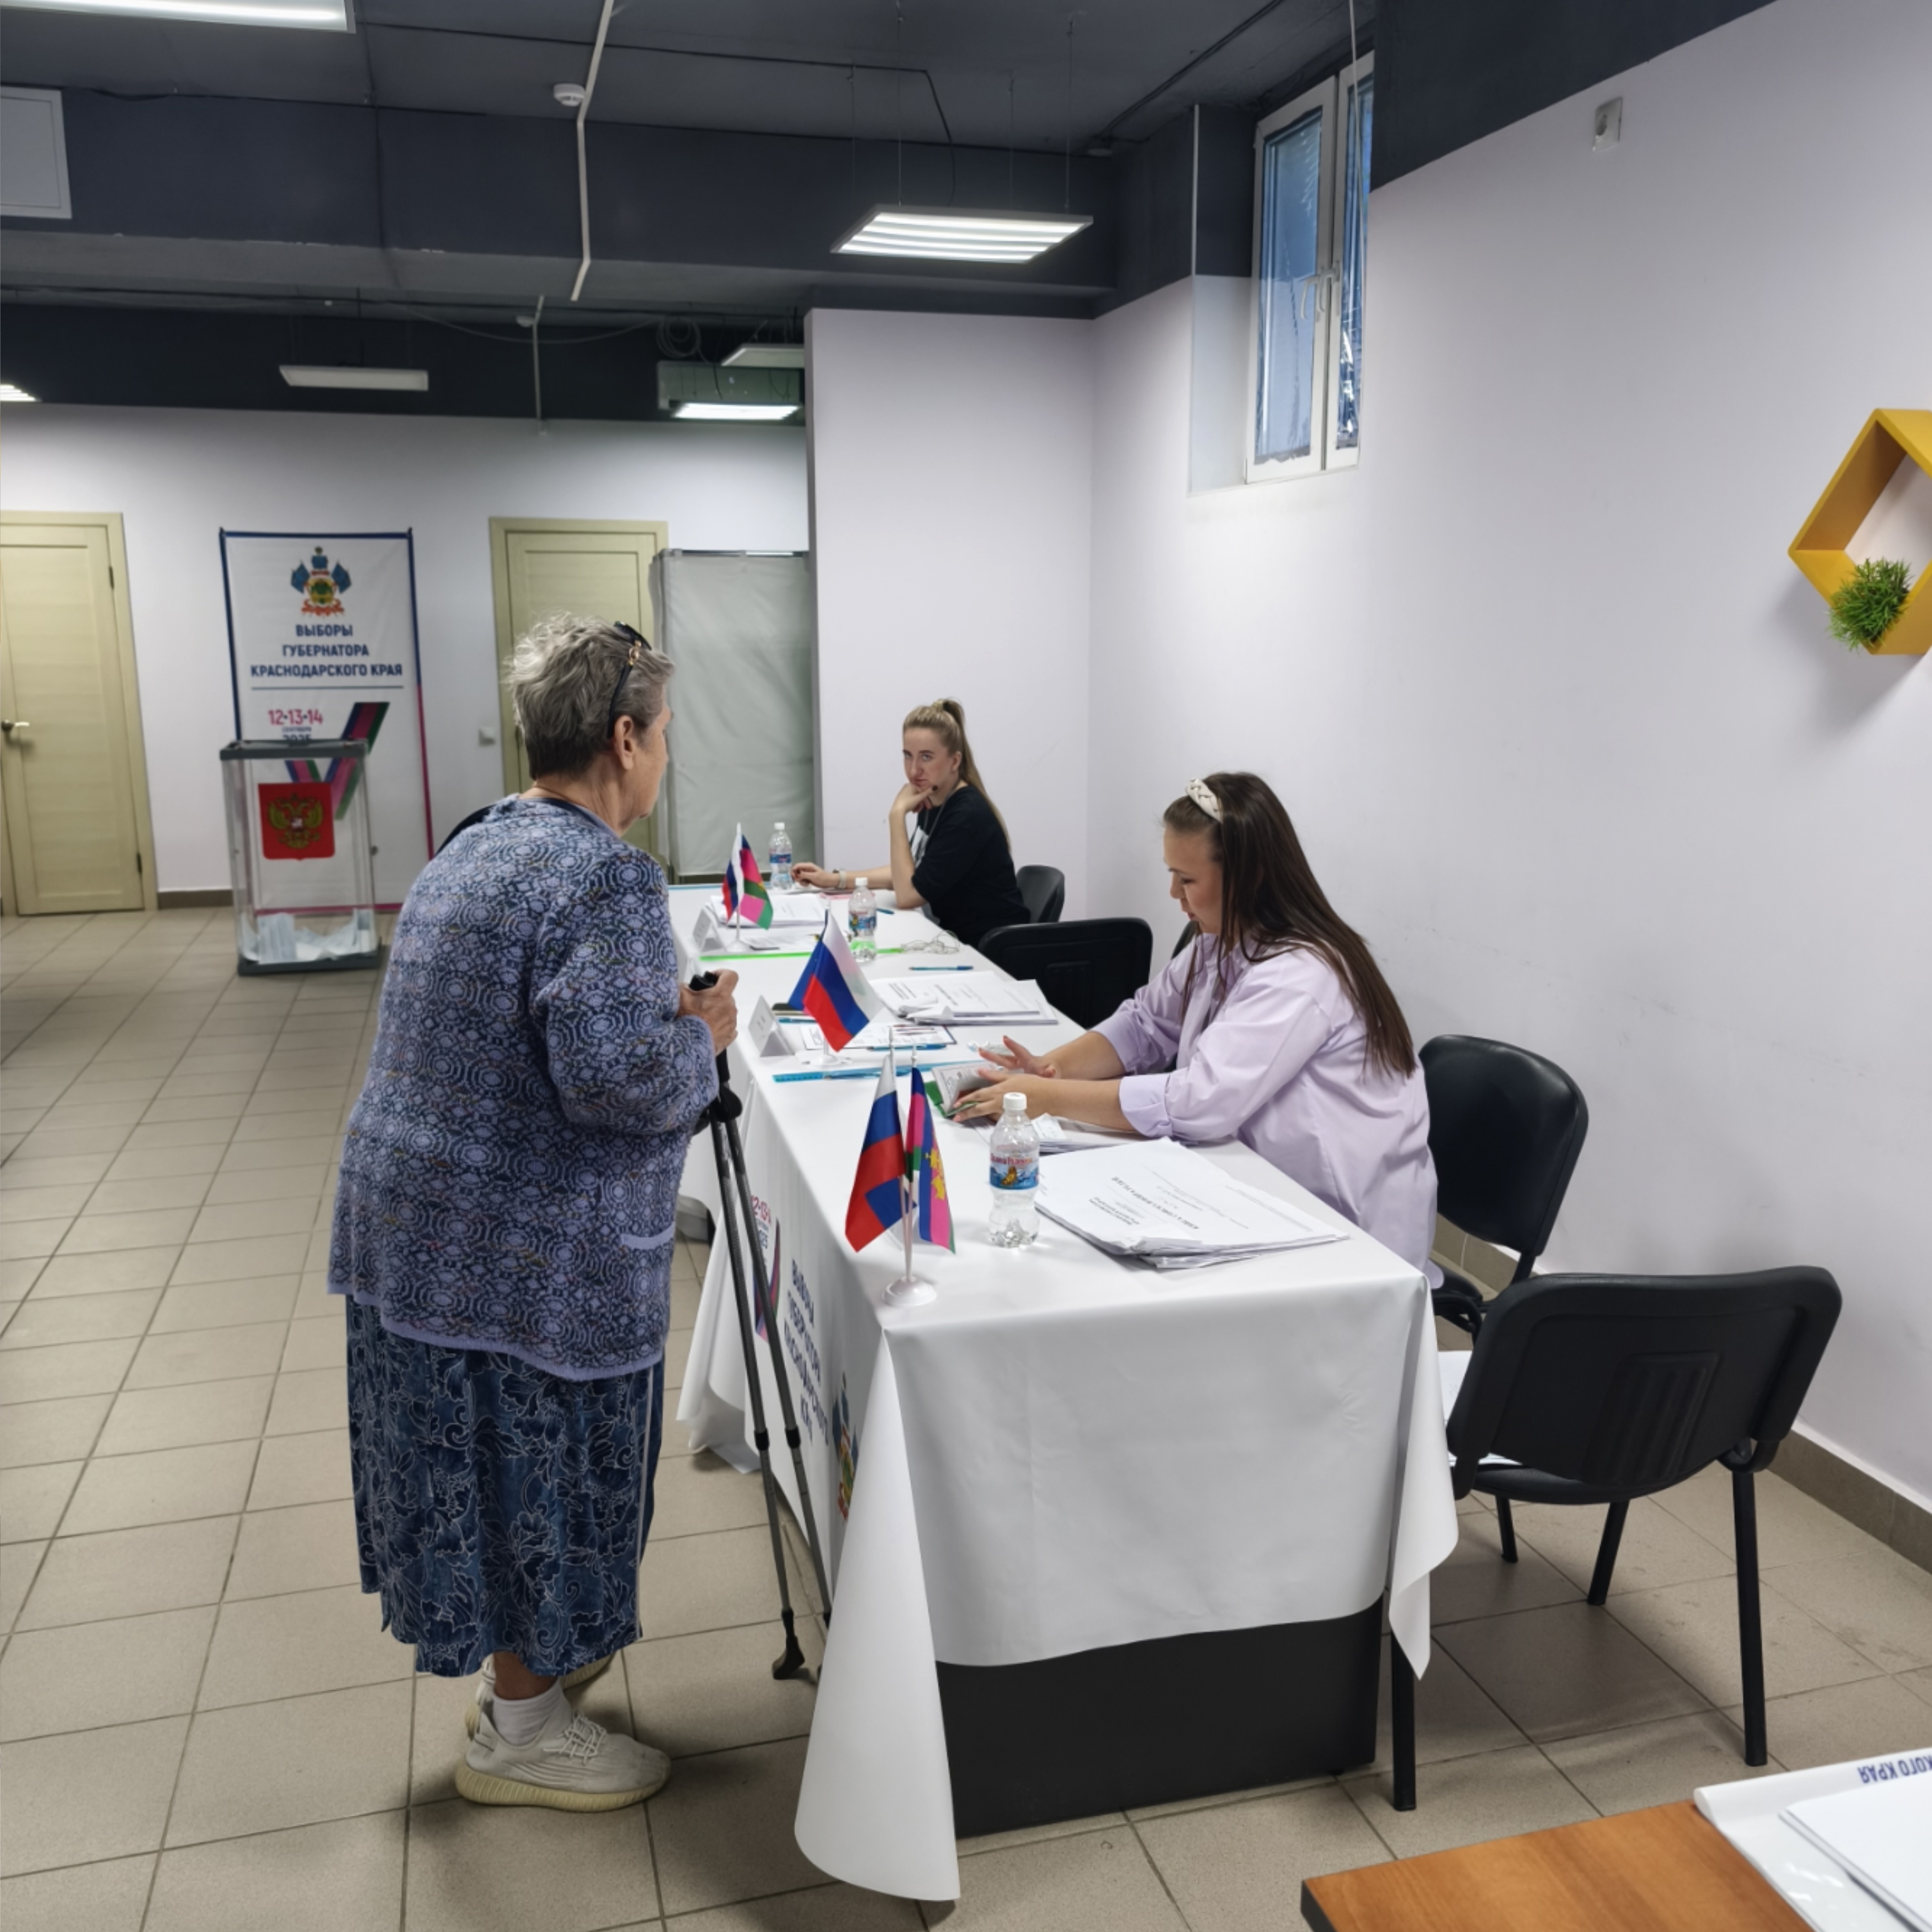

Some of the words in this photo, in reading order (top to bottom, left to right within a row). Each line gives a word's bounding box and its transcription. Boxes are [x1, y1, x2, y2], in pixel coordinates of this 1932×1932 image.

[296, 625, 353, 637] ВЫБОРЫ
[283, 644, 369, 656] ГУБЕРНАТОРА
[251, 665, 367, 678] КРАСНОДАРСКОГО
[370, 665, 402, 676] КРАЯ
[1857, 1762, 1898, 1784] КРАЯ
